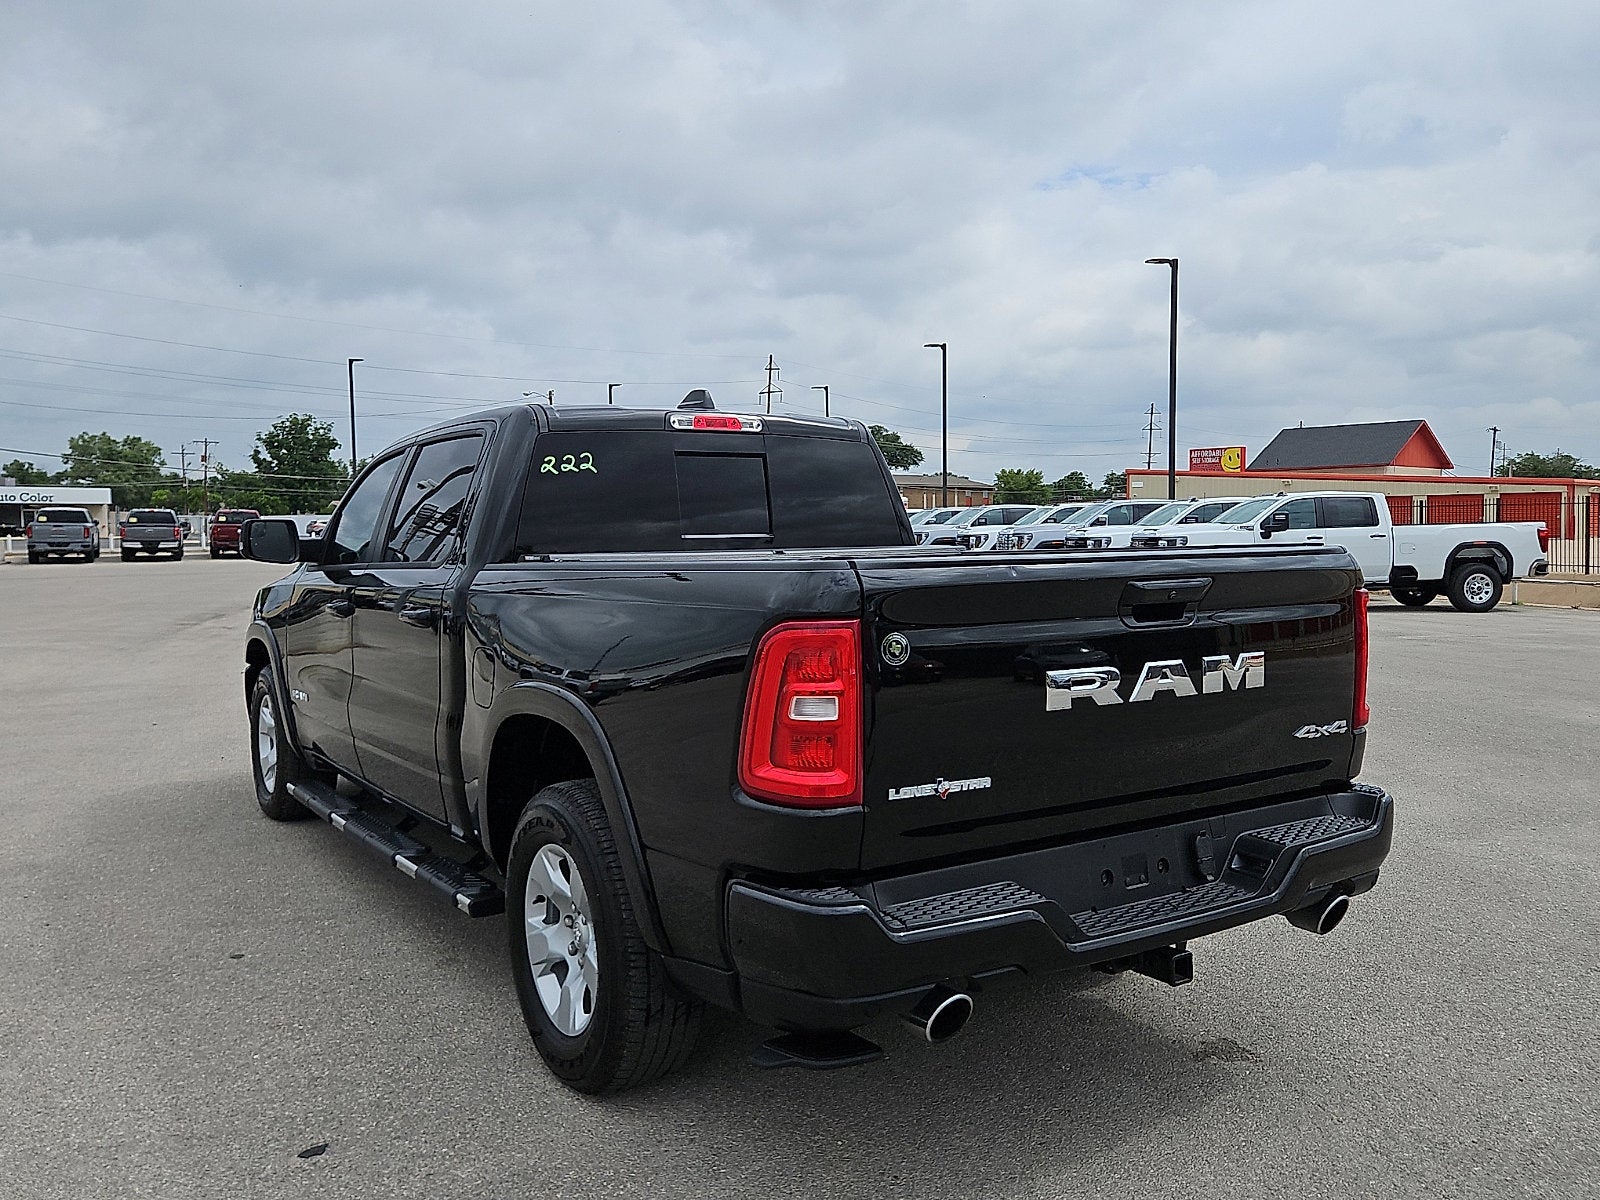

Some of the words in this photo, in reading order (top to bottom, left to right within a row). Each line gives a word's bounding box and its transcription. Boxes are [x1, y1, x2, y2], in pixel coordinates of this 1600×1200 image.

[540, 452, 598, 475] 222
[1191, 450, 1225, 458] AFFORDABLE
[19, 492, 54, 502] Color
[1045, 651, 1265, 711] RAM
[888, 783, 938, 801] LONE
[948, 776, 992, 793] STAR
